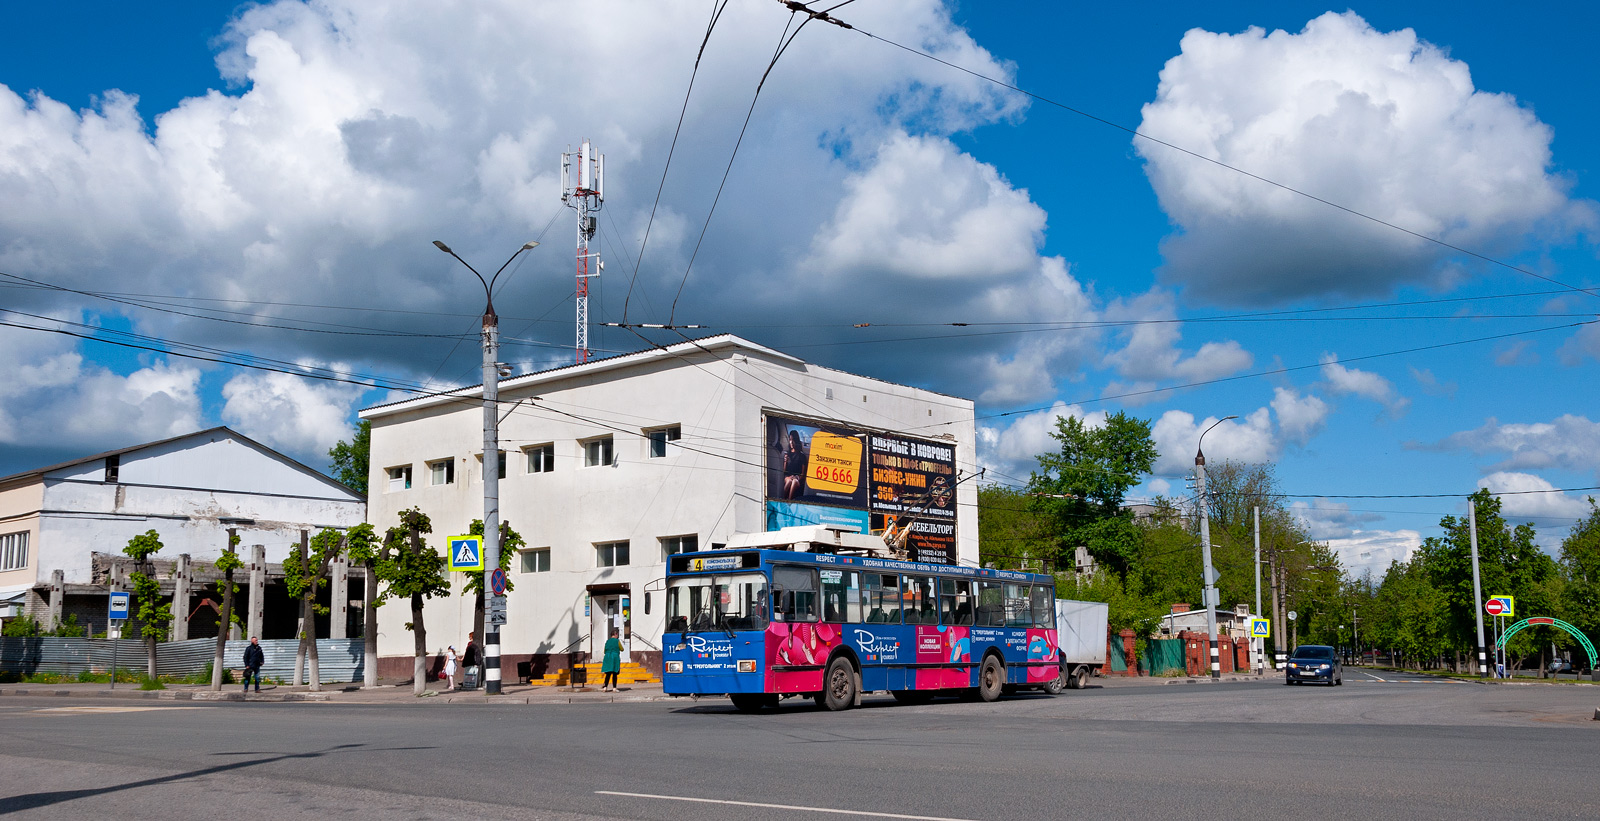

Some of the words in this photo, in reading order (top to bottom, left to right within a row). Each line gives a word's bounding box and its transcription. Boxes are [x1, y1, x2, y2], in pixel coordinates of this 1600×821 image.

[825, 442, 843, 450] maxim
[872, 437, 908, 454] ВПЕРВЫЕ
[911, 442, 916, 456] В
[917, 444, 952, 462] КОВРОВЕ!
[816, 454, 836, 463] Закажи
[872, 454, 896, 467] ТОЛЬКО
[897, 457, 901, 468] В
[902, 458, 918, 470] КАФЕ
[816, 466, 828, 480] 69
[832, 468, 852, 484] 666
[873, 468, 926, 488] БИЗНЕС-УЖИН
[877, 486, 893, 501] 350
[695, 560, 702, 571] 4
[816, 555, 836, 563] RESPECT
[863, 560, 884, 568] УДОБНАЯ
[884, 561, 916, 570] КАЧЕСТВЕННАЯ
[917, 563, 930, 571] ОБУВЬ
[931, 564, 937, 572] ПО
[686, 636, 733, 660] Respect
[854, 629, 899, 663] Respect
